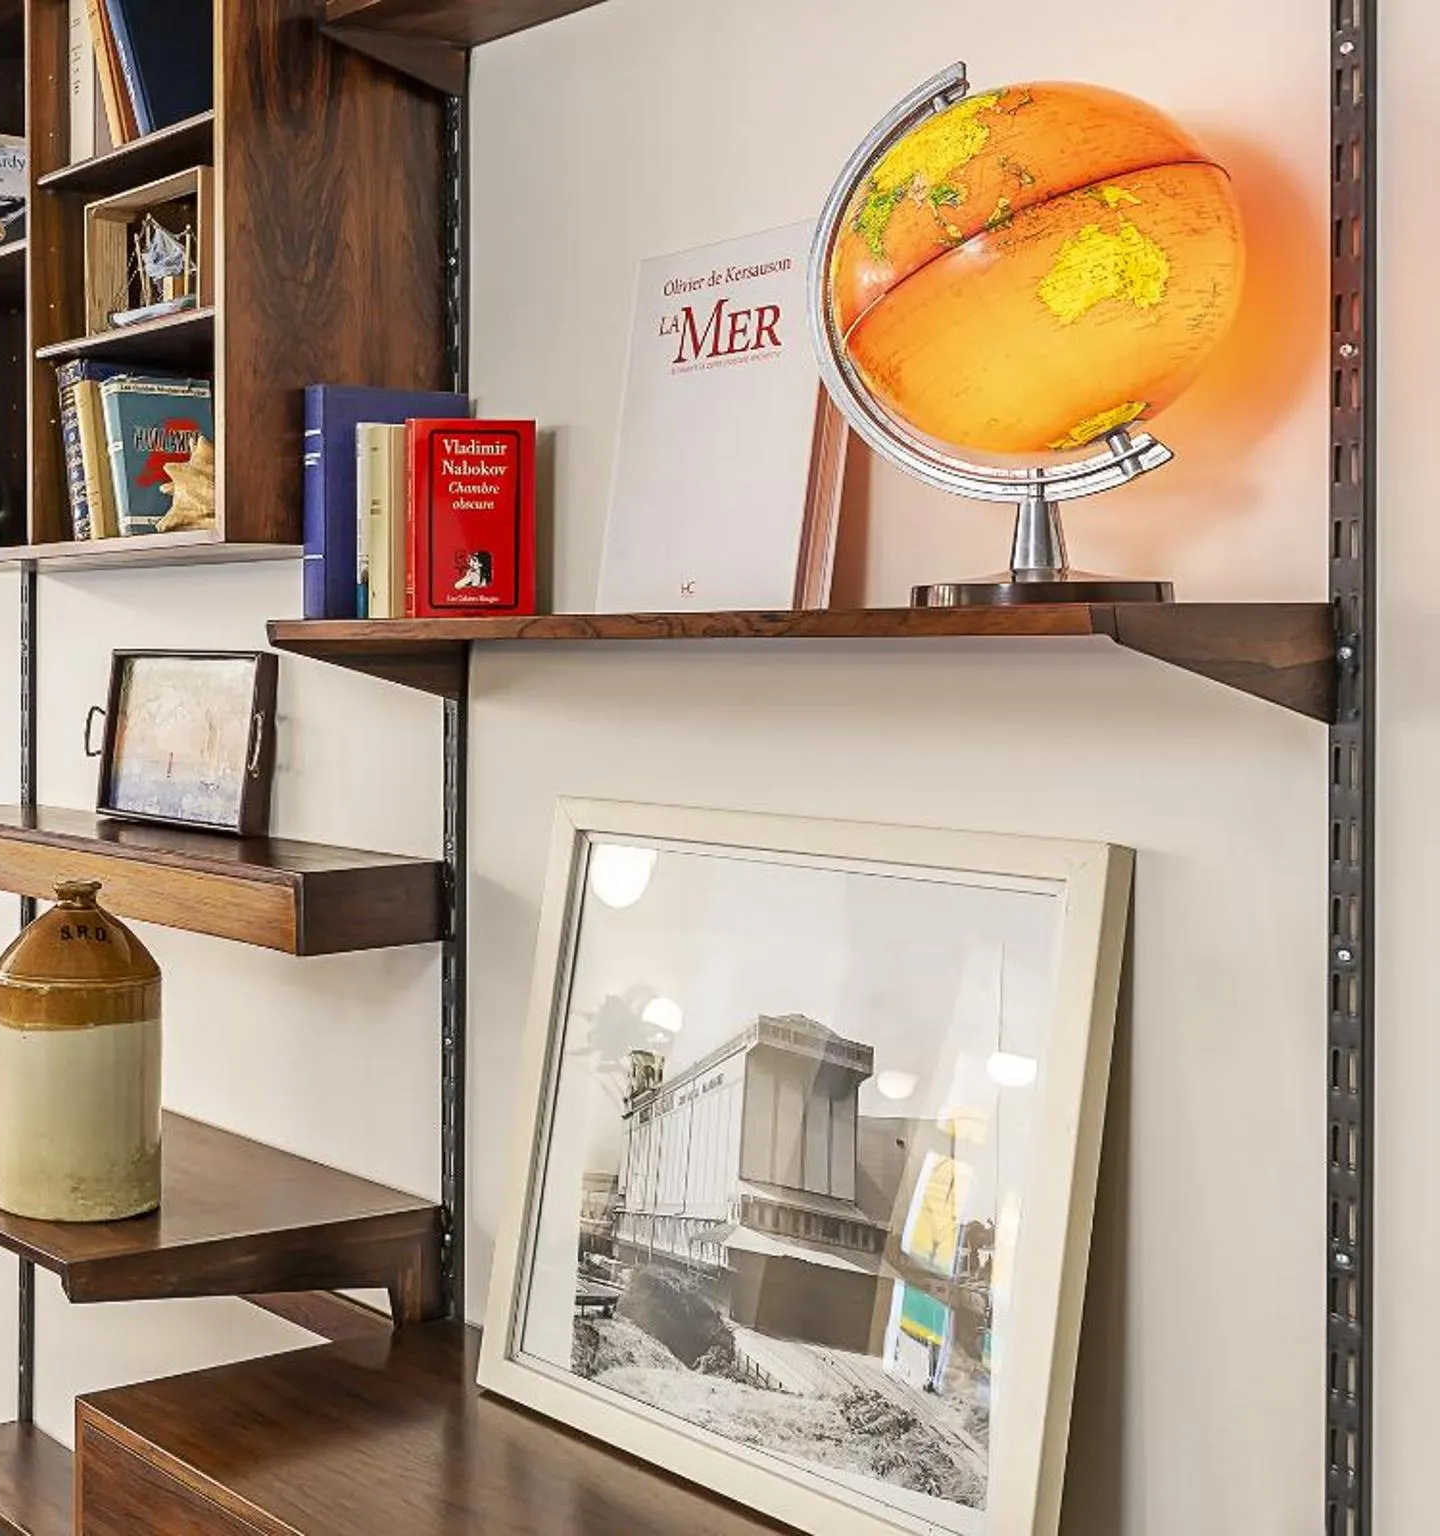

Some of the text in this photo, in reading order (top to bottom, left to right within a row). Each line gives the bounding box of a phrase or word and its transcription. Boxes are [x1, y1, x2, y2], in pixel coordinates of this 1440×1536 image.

[663, 258, 792, 297] Olivier de Kersauson
[658, 314, 680, 337] LA
[672, 298, 782, 364] MER
[443, 438, 508, 456] Vladimir
[441, 459, 508, 477] Nabokov
[448, 481, 501, 495] Chambre
[452, 497, 495, 510] obscure
